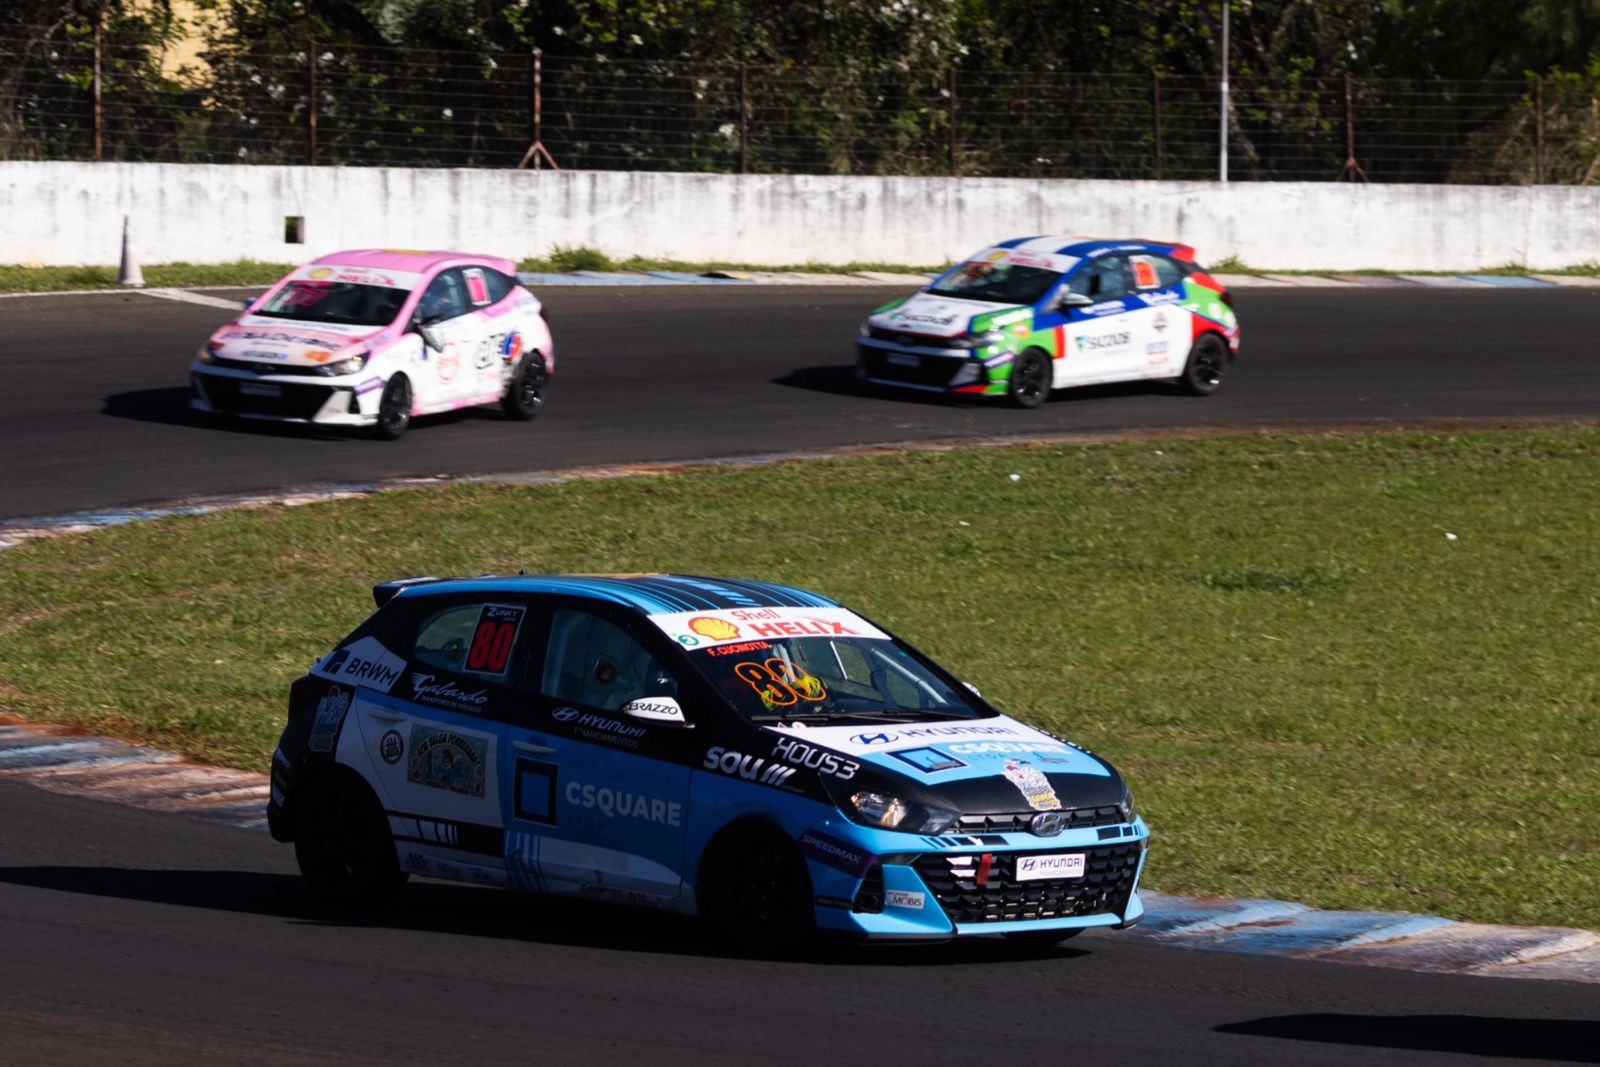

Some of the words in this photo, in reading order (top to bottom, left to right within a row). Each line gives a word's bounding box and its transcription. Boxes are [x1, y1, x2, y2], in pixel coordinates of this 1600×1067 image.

[730, 608, 781, 621] Shell
[747, 619, 861, 637] HELIX
[468, 619, 514, 672] 80
[345, 657, 400, 686] BRWM
[629, 702, 678, 715] BRAZZO
[578, 713, 648, 738] HYUNDAI
[898, 727, 1020, 738] HYUNDAI
[565, 781, 682, 828] CSQUARE
[801, 834, 864, 864] SPEEDMAX
[1040, 858, 1083, 869] HYUNDAI
[892, 895, 922, 906] MOBIS
